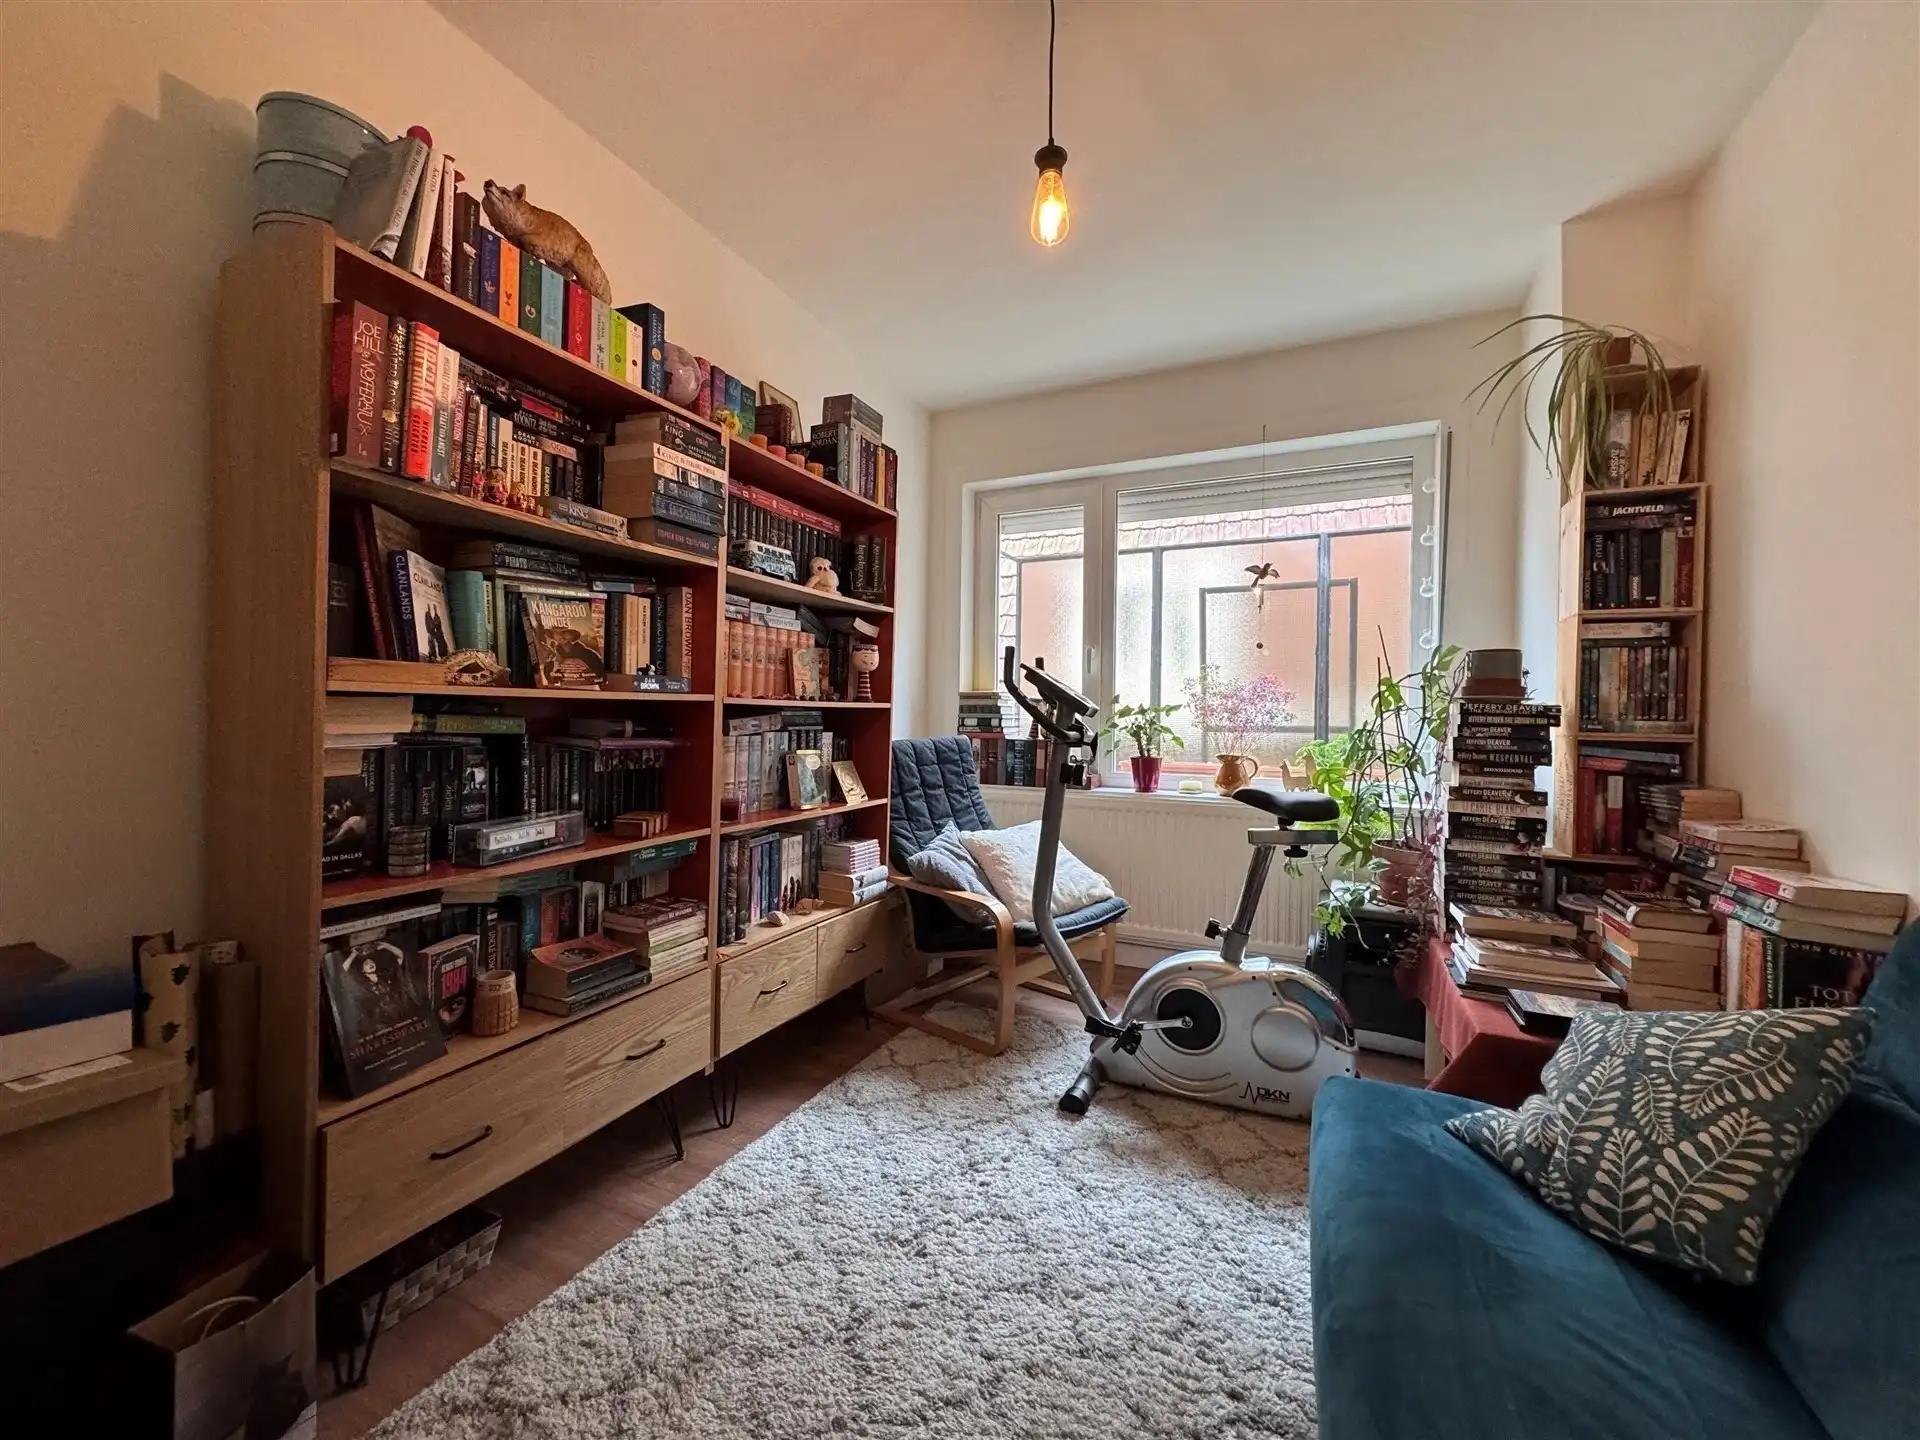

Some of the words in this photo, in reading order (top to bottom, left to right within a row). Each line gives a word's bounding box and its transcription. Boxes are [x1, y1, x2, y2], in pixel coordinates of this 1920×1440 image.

[358, 319, 382, 338] JOE
[353, 331, 385, 354] HILL
[412, 332, 438, 413] AIRFRAME
[453, 406, 464, 441] CRICHTON
[664, 424, 684, 439] KING
[811, 437, 838, 448] JORDAN
[813, 430, 837, 440] ROBERT
[1610, 448, 1619, 477] ZUSSEN
[1612, 504, 1664, 516] JACHTVELD
[395, 555, 412, 621] CLANLANDS
[531, 600, 587, 619] KANGAROO
[684, 592, 692, 615] DAN
[541, 614, 573, 629] DUNDEE
[683, 616, 692, 658] BROWN
[640, 682, 660, 690] BROWN
[1506, 704, 1544, 712] DEAVER
[1483, 789, 1507, 797] DEAVER
[332, 854, 339, 862] IN
[340, 851, 363, 861] DALLAS
[1811, 984, 1853, 1002] TOT
[1257, 1086, 1290, 1098] DKN
